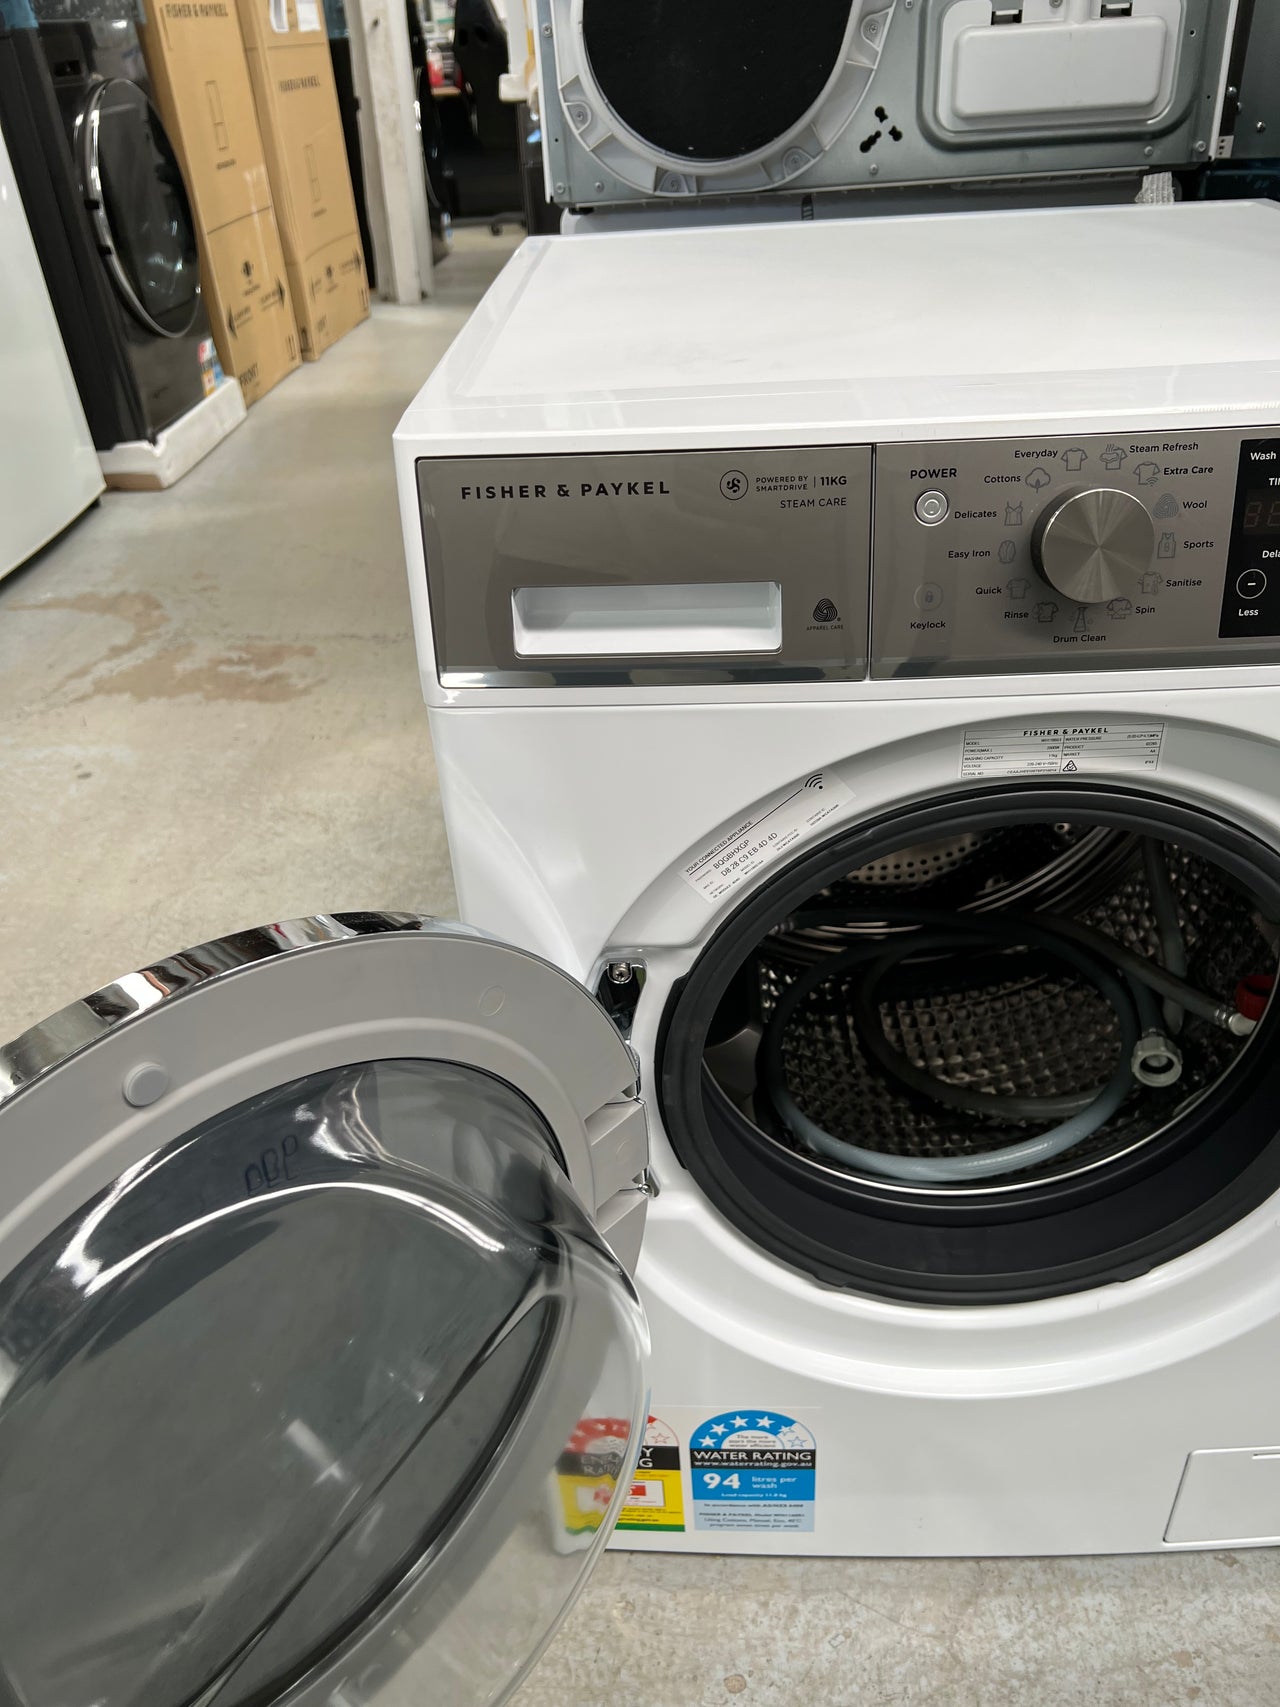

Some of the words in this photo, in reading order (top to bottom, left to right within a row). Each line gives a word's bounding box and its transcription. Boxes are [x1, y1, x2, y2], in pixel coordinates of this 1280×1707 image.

[1129, 444, 1160, 453] Steam
[1162, 443, 1199, 452] Refresh
[1014, 450, 1058, 458] Everyday
[1250, 452, 1276, 461] Wash
[910, 468, 958, 480] POWER
[1163, 467, 1188, 476] Extra
[1192, 466, 1214, 474] Care
[756, 476, 796, 484] POWERED
[820, 476, 847, 486] 11KG
[984, 475, 1022, 484] Cottons
[461, 484, 547, 500] FISHER
[557, 484, 570, 498] &
[580, 481, 670, 497] PAYKEL
[756, 484, 808, 492] SMARTDRIVE
[780, 500, 815, 509] STEAM
[818, 498, 847, 507] CARE
[1182, 501, 1208, 509] Wool
[954, 510, 998, 520] Delicates
[1183, 540, 1214, 550] Sports
[948, 550, 969, 560] Easy
[972, 550, 991, 558] Iron
[1166, 578, 1202, 587] Sanitise
[975, 586, 1002, 596] Quick
[1004, 611, 1029, 619] Rinse
[1135, 606, 1156, 615] Spin
[1238, 608, 1259, 616] Less
[910, 621, 946, 630] Keylock
[1053, 635, 1078, 643] Drum
[1081, 634, 1106, 642] Clean
[686, 862, 700, 873] YOUR
[698, 840, 728, 863] CONNECTED
[727, 821, 753, 842] APPLIANCE
[730, 861, 740, 870] 28
[738, 854, 749, 863] C9
[758, 840, 768, 848] 4D
[768, 832, 778, 841] 4D
[694, 1451, 748, 1460] WATER
[752, 1452, 812, 1460] RATING
[694, 1460, 812, 1468] www.waterrating.gov.au
[703, 1472, 740, 1489] 94
